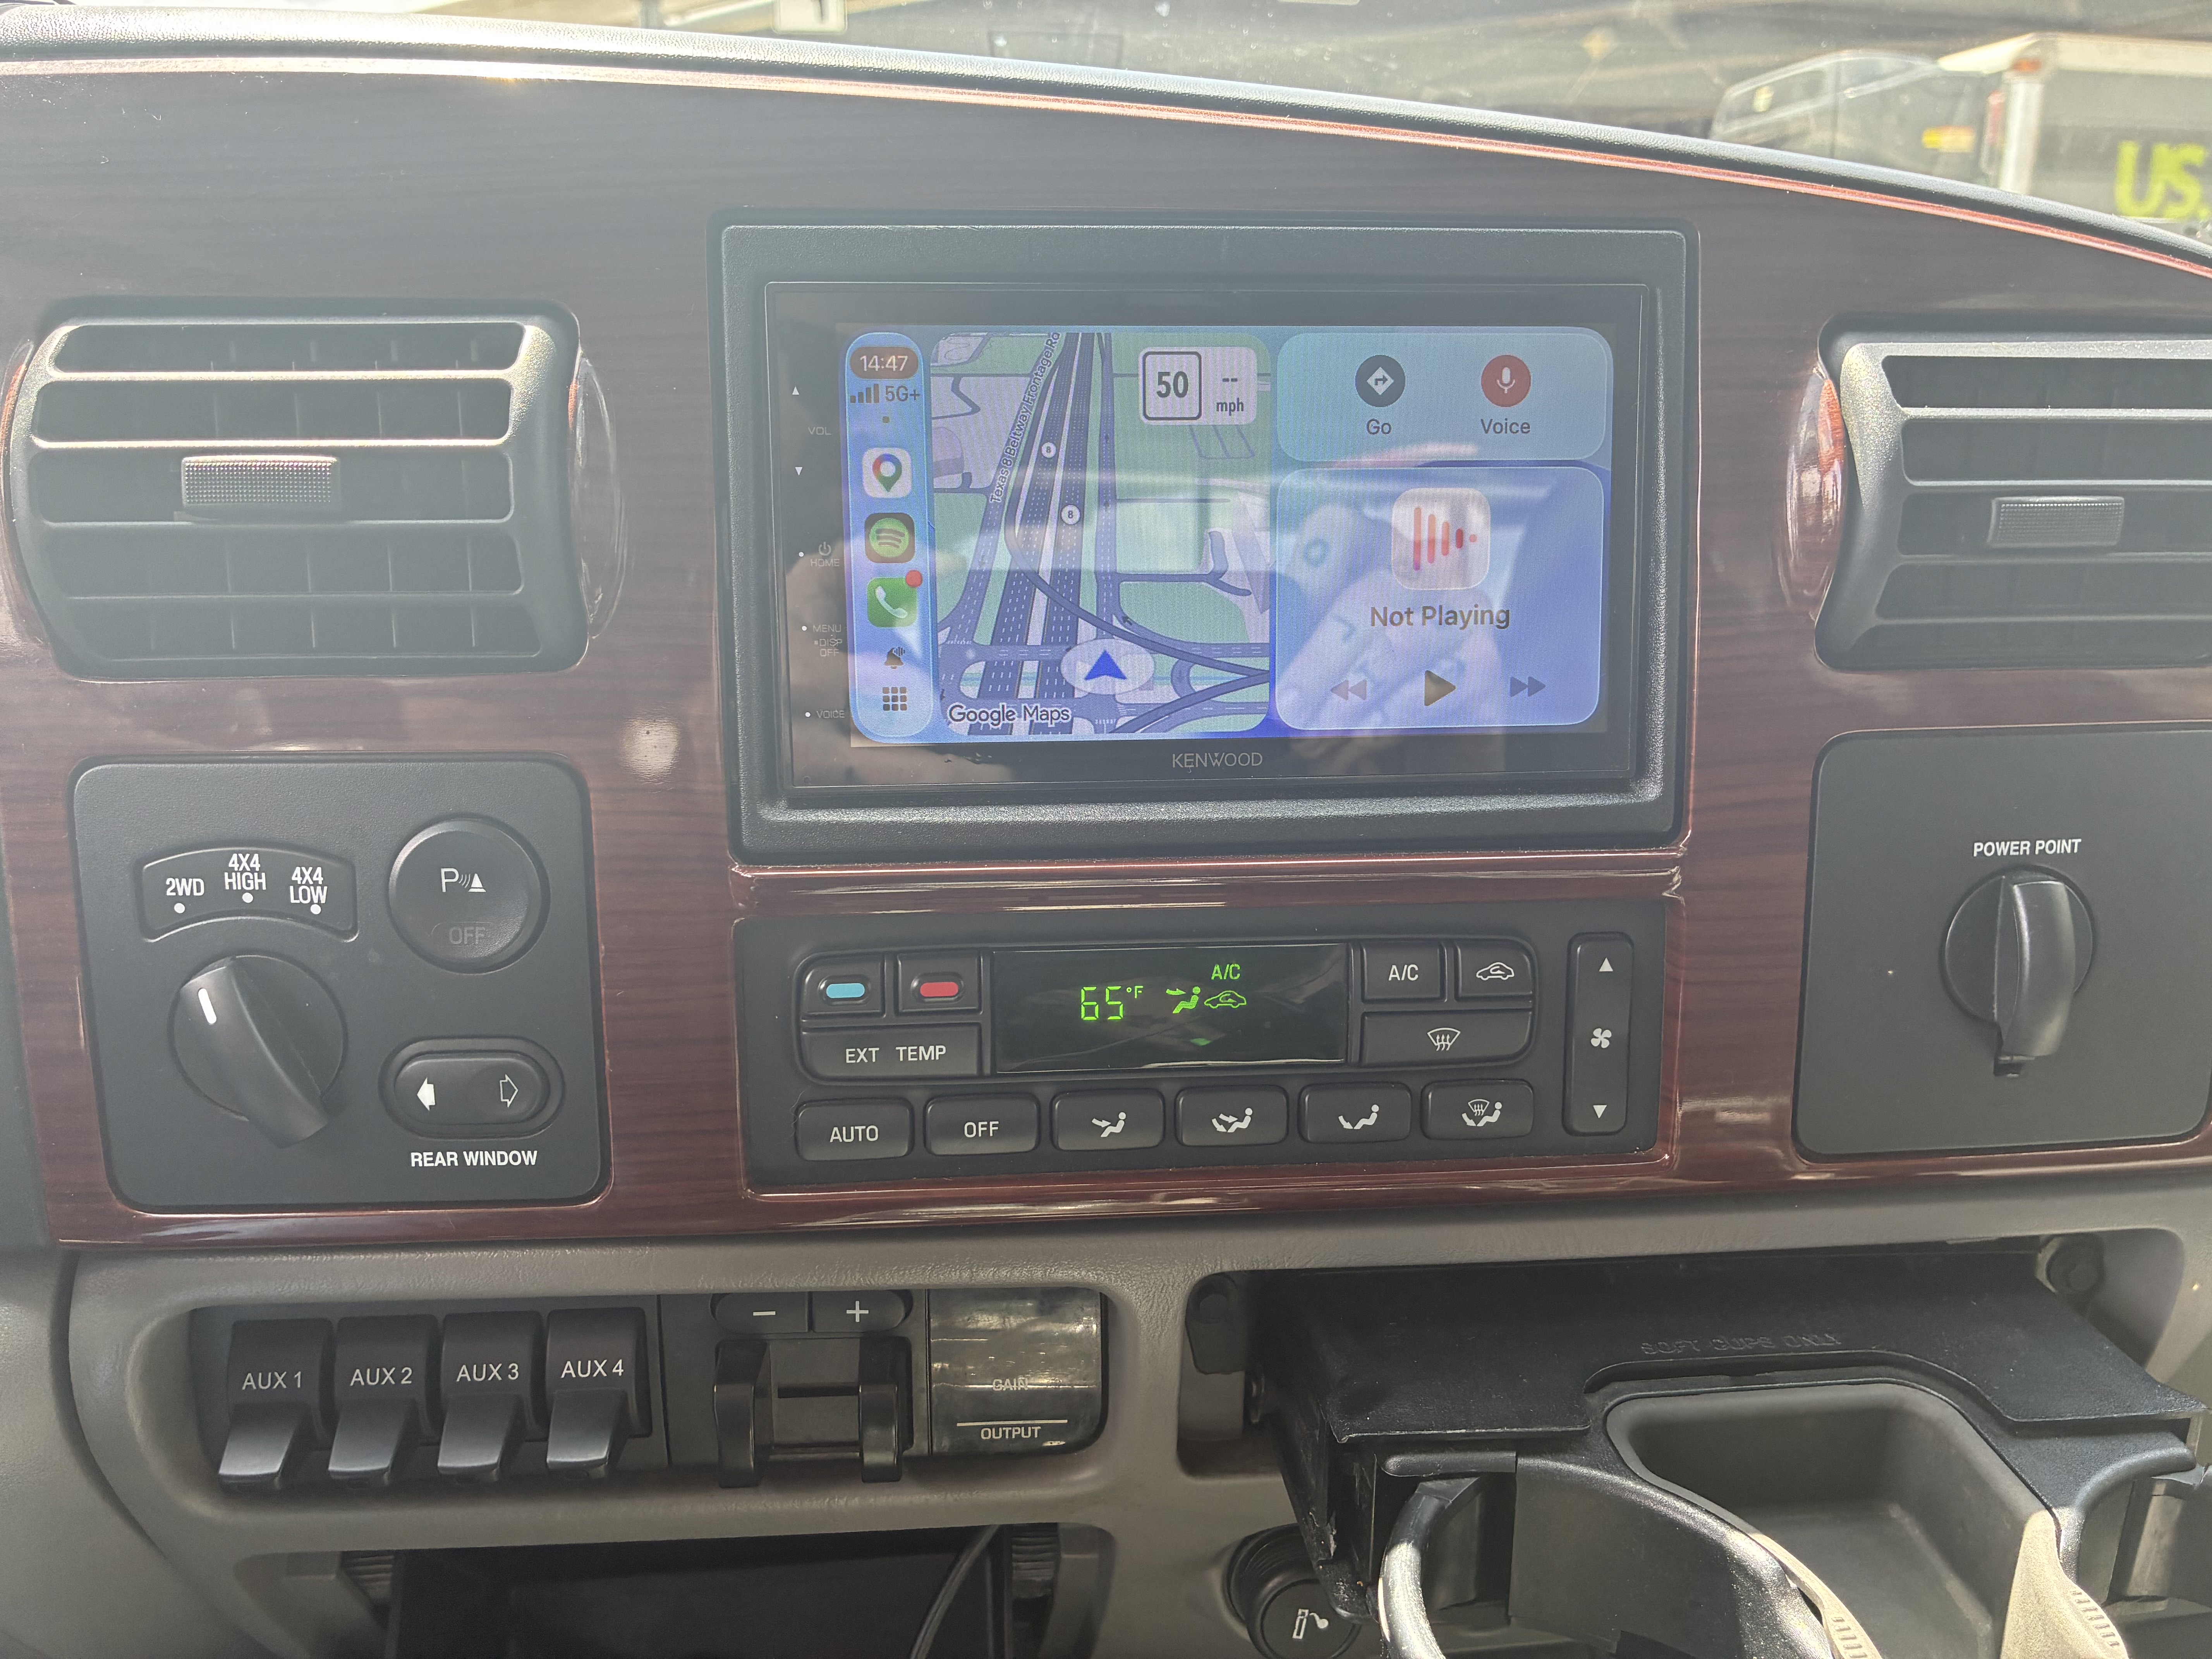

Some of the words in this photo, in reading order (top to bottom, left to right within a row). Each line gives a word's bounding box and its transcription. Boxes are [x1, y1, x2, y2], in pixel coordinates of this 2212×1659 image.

[860, 355, 908, 371] 14:47
[1022, 349, 1053, 405] Frontage
[1156, 371, 1189, 398] 50
[885, 385, 920, 402] 5G+
[1216, 397, 1244, 416] mph
[809, 427, 831, 436] VOL
[1005, 405, 1032, 457] Beltway
[1366, 419, 1392, 435] Go
[1480, 418, 1531, 434] Voice
[1002, 458, 1012, 467] 8
[989, 468, 1010, 502] Texas
[1068, 510, 1073, 519] 8
[810, 558, 840, 567] HOME
[1370, 606, 1414, 627] Not
[1422, 604, 1511, 630] Playing
[820, 649, 839, 657] OFF
[816, 710, 845, 718] VOICE
[949, 704, 1016, 726] Google
[1023, 703, 1071, 725] Maps
[1172, 752, 1263, 768] KENWOOD
[1973, 840, 2030, 857] POWER
[2035, 838, 2082, 855] POINT
[228, 853, 261, 871] 4X4
[224, 872, 266, 890] HIGH
[292, 867, 324, 884] 4X4
[166, 878, 204, 896] 2WD
[289, 886, 328, 904] LOW
[449, 927, 486, 945] OFF
[1211, 963, 1241, 980] A/C
[1388, 964, 1419, 981] A/C
[1081, 986, 1123, 1020] 65
[846, 1047, 879, 1063] EXT
[895, 1045, 946, 1061] TEMP
[830, 1125, 879, 1143] AUTO
[964, 1121, 999, 1137] OFF
[410, 1151, 459, 1167] REAR
[463, 1150, 538, 1166] WINDOW
[350, 1367, 395, 1386] AUX
[401, 1367, 412, 1384] 2
[456, 1363, 502, 1382] AUX
[508, 1363, 519, 1380] 3
[561, 1359, 607, 1378] AUX
[612, 1359, 624, 1376] 4
[242, 1372, 287, 1390] AUX
[294, 1371, 302, 1388] 1
[992, 1377, 1029, 1391] GAIN
[981, 1426, 1041, 1440] OUTPUT
